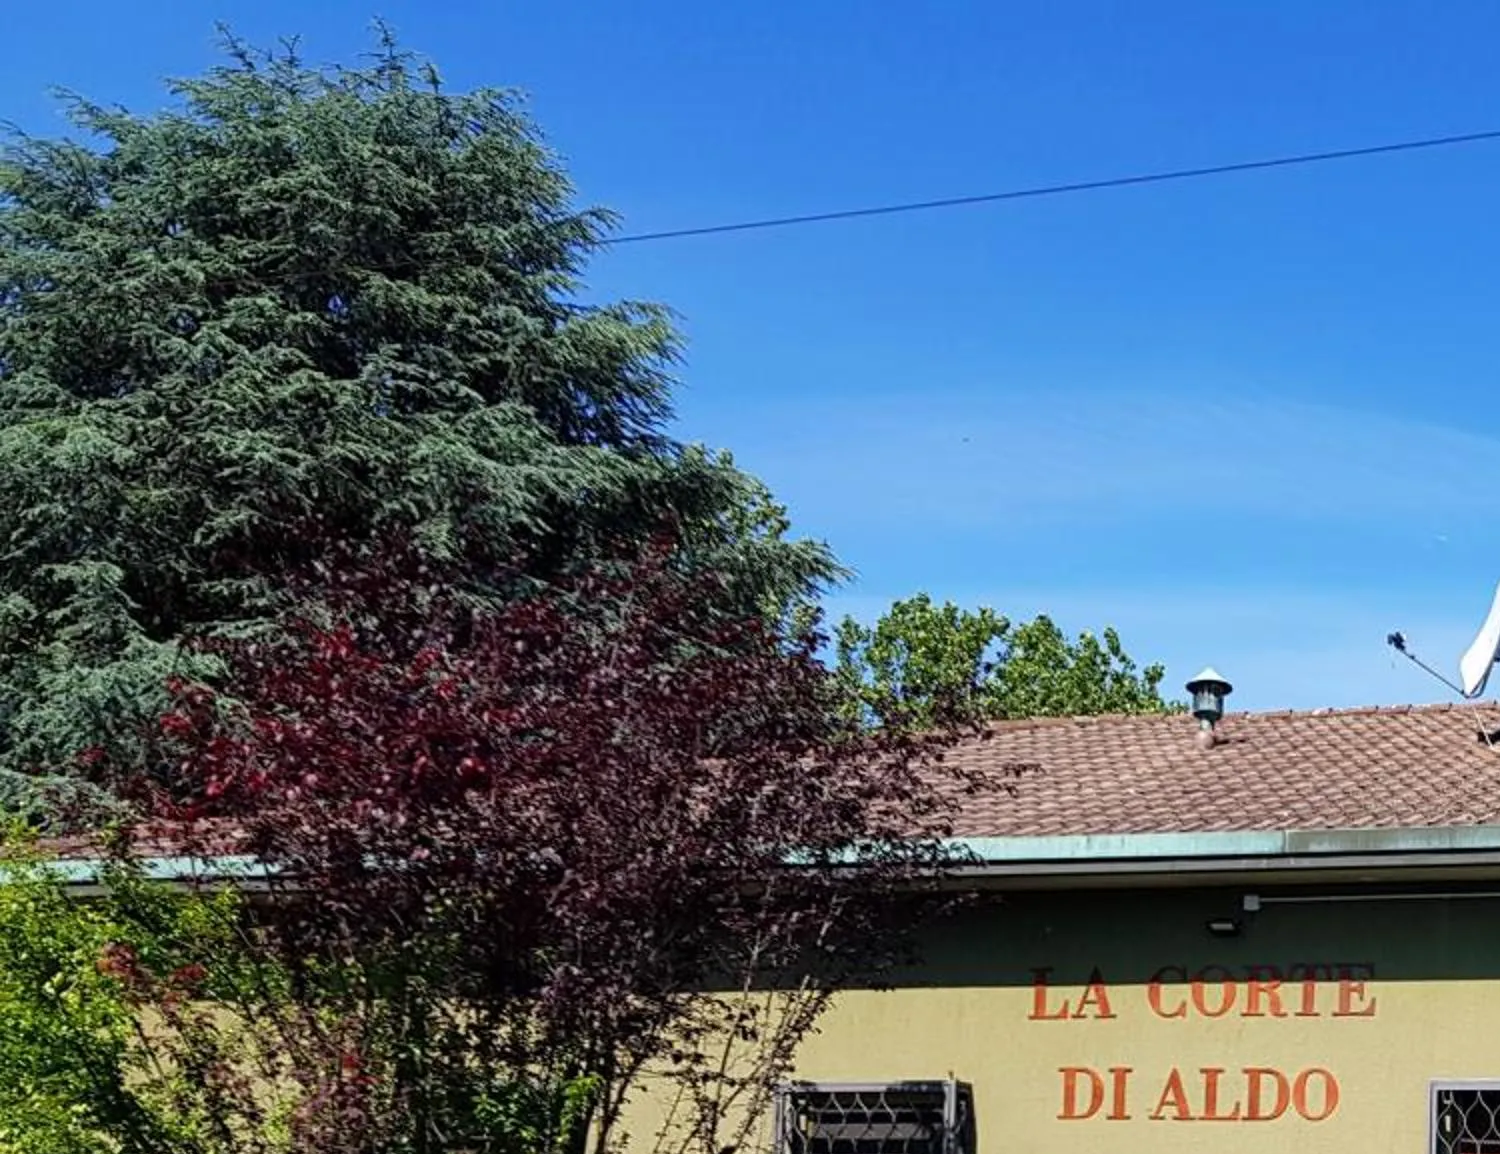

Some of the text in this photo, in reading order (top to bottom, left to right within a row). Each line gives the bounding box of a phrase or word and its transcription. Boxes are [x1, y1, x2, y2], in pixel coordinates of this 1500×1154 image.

[1027, 962, 1377, 1020] LA CORTE
[1056, 1067, 1341, 1122] DI ALDO
